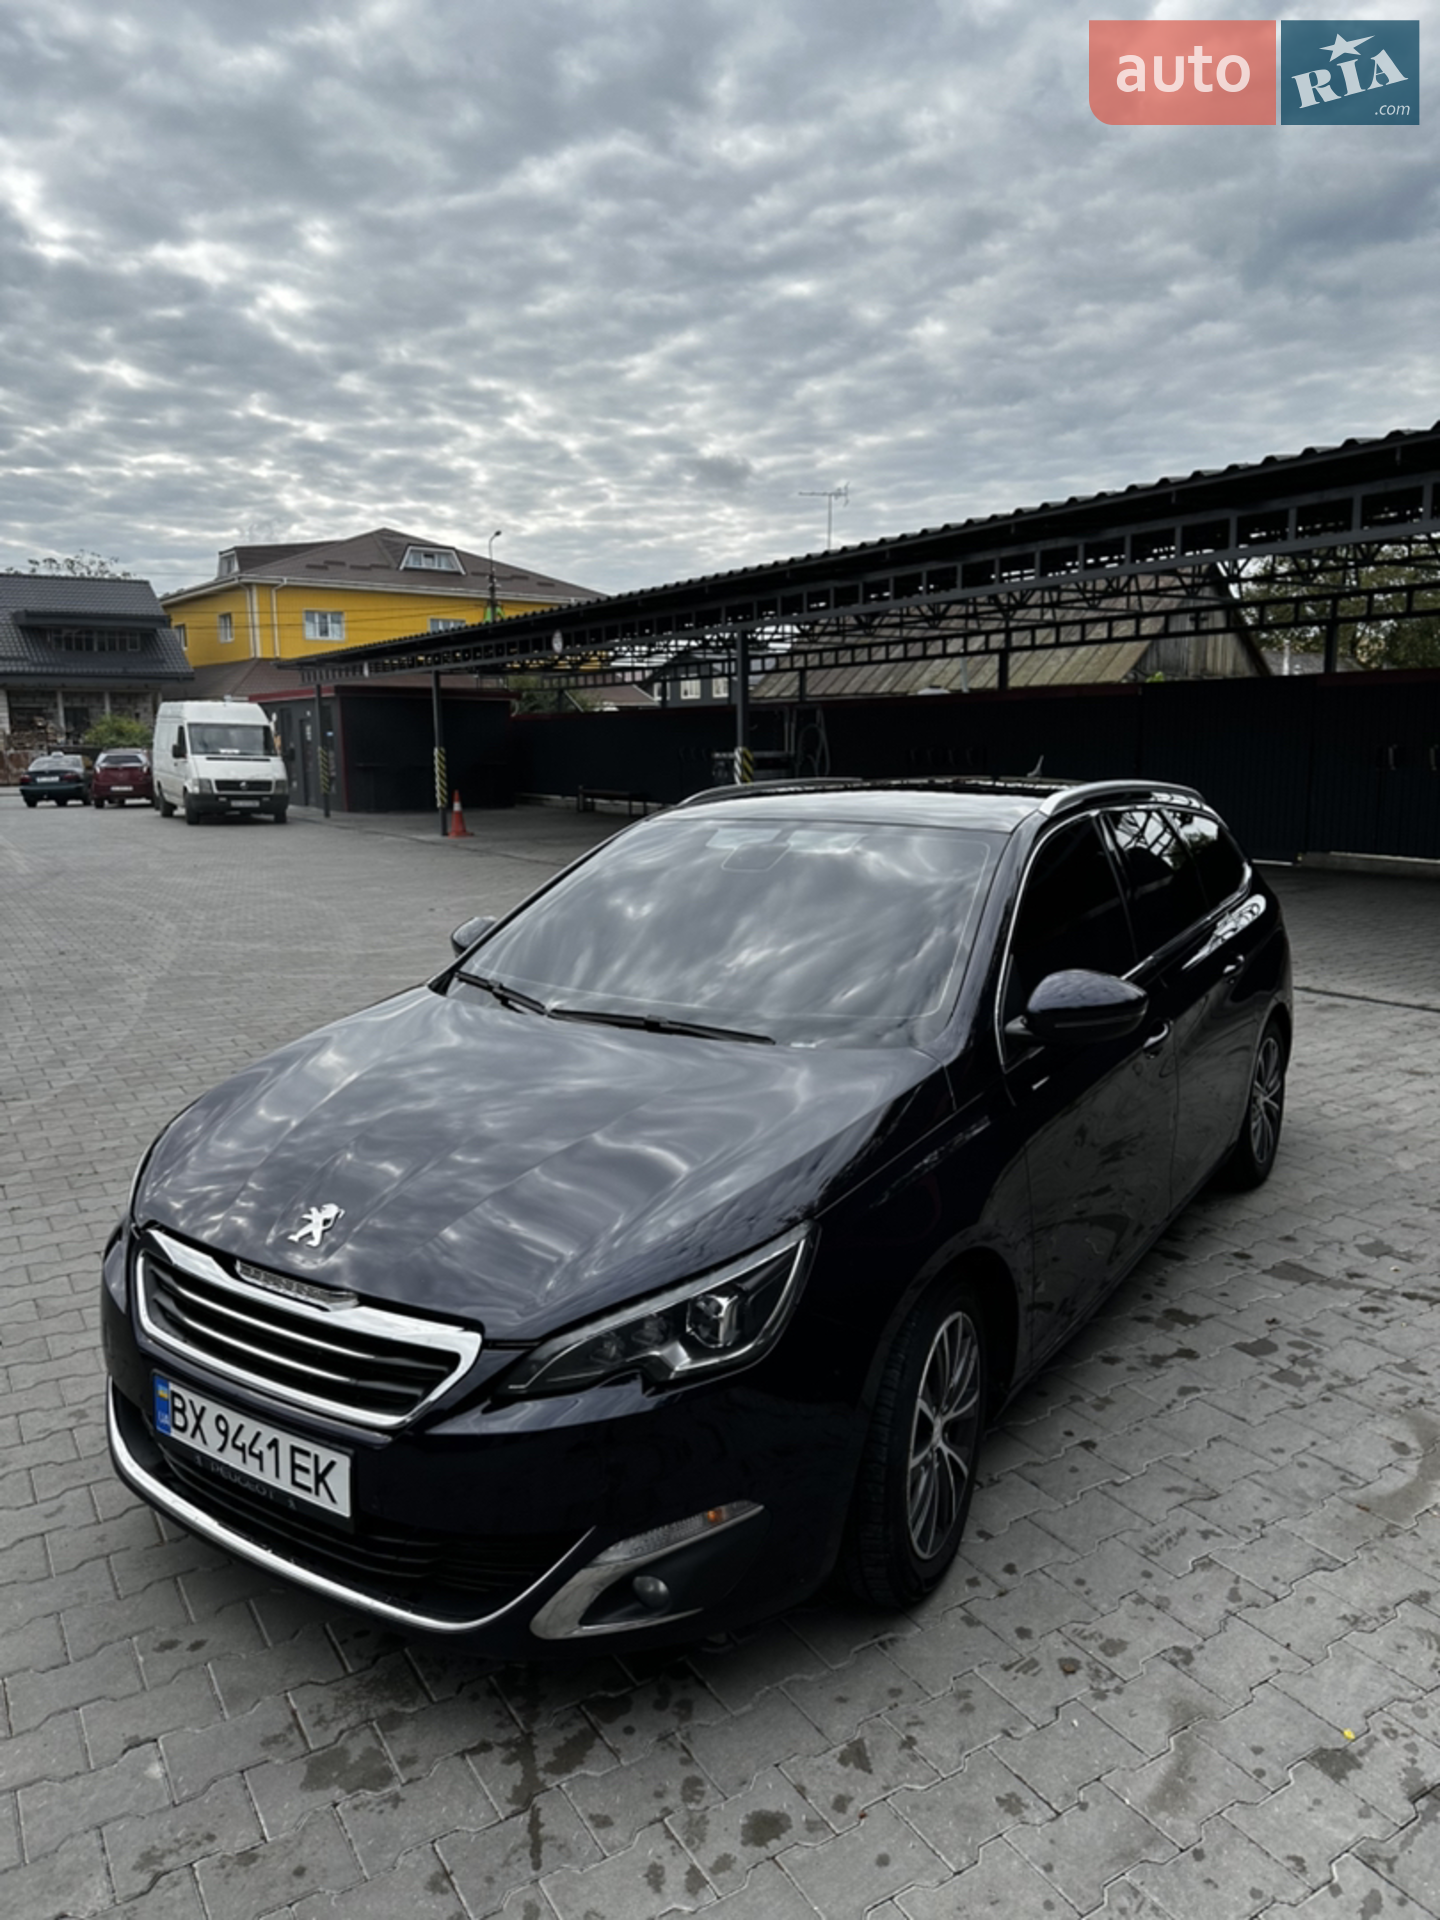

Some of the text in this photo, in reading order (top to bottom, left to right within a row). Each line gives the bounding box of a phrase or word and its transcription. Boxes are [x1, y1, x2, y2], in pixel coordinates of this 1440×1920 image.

[171, 1390, 338, 1505] BX 9441 EK
